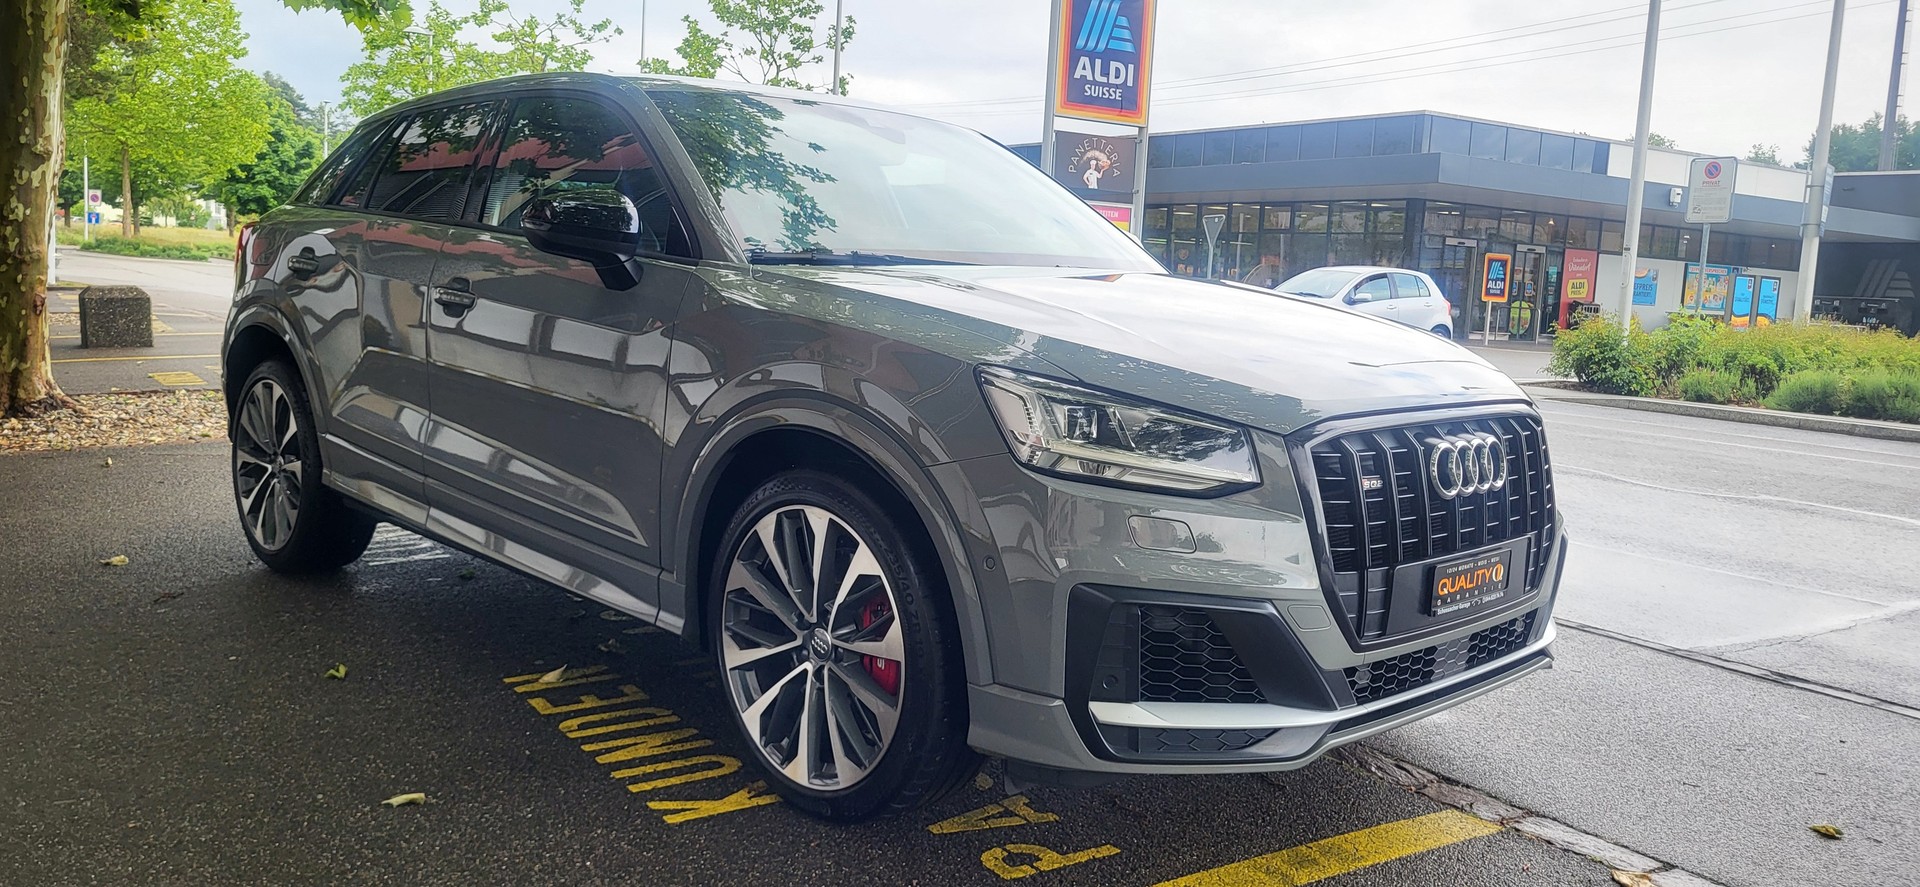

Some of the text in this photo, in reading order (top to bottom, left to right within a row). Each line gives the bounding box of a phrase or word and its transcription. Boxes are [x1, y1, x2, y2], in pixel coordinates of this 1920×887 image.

[1073, 56, 1135, 87] ALDI
[1084, 84, 1123, 100] SUISSE
[1068, 137, 1121, 178] PANETTERIA
[1487, 280, 1504, 289] ALDI
[1571, 281, 1585, 290] ALDI
[1363, 480, 1383, 488] SQ2
[1438, 567, 1493, 596] QUALITY
[1437, 583, 1502, 606] GARANTIE
[502, 664, 783, 825] KUNDEN
